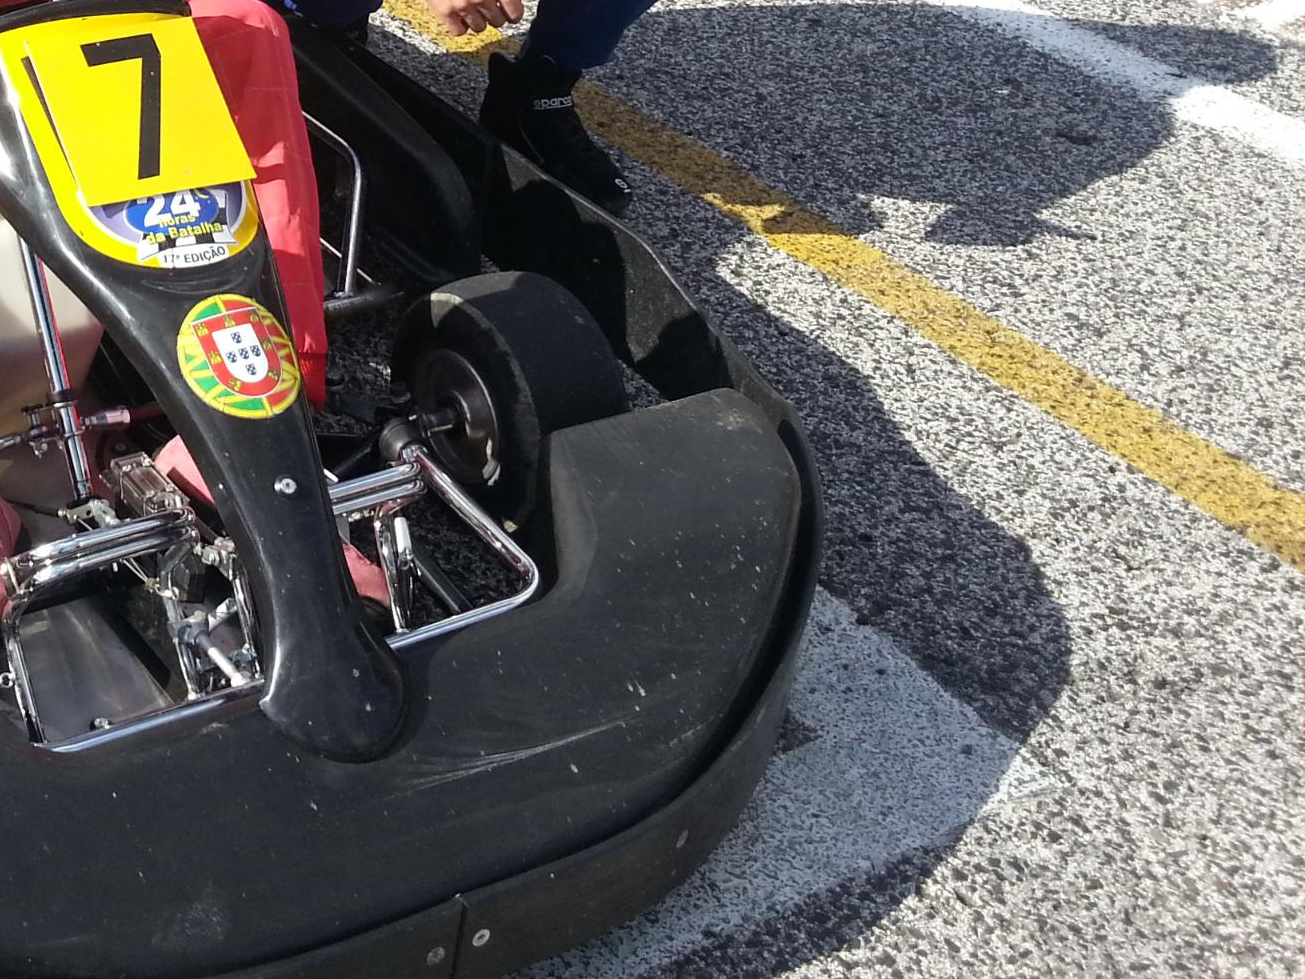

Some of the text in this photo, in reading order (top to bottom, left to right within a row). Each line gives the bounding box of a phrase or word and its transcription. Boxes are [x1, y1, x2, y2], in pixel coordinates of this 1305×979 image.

[80, 32, 162, 181] 7
[143, 189, 202, 228] 24
[146, 221, 224, 245] da Batalha
[183, 245, 227, 264] EDIÇÃO
